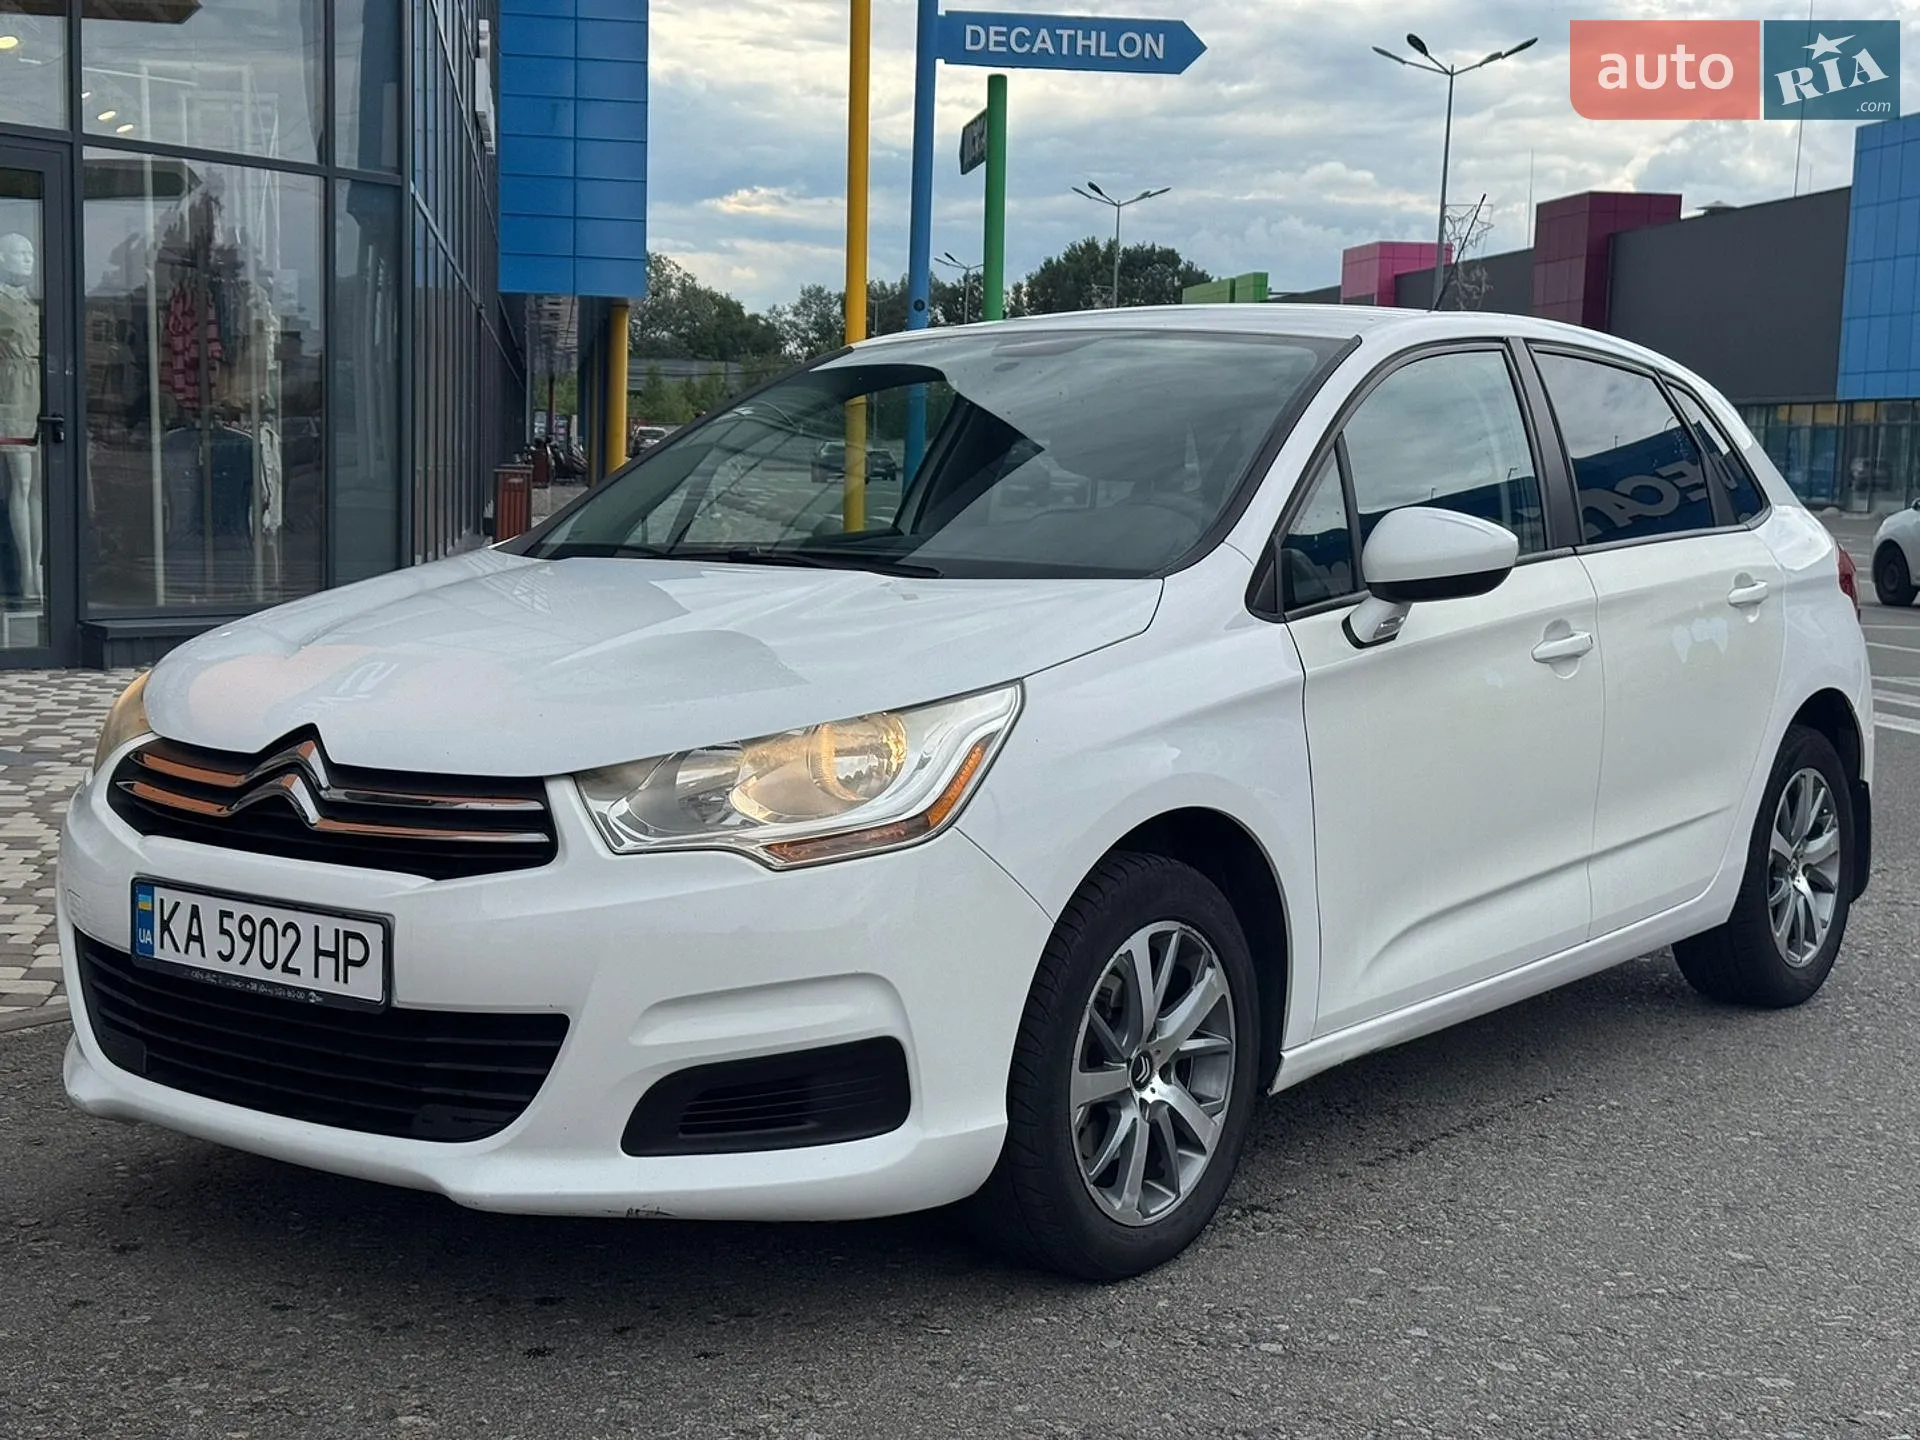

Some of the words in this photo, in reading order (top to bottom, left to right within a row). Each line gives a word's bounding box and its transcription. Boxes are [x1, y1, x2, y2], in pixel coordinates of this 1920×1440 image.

[965, 24, 1165, 59] DECATHLON
[138, 929, 153, 945] UA
[159, 897, 207, 959] KA
[216, 909, 302, 976] 5902
[313, 925, 370, 984] HP
